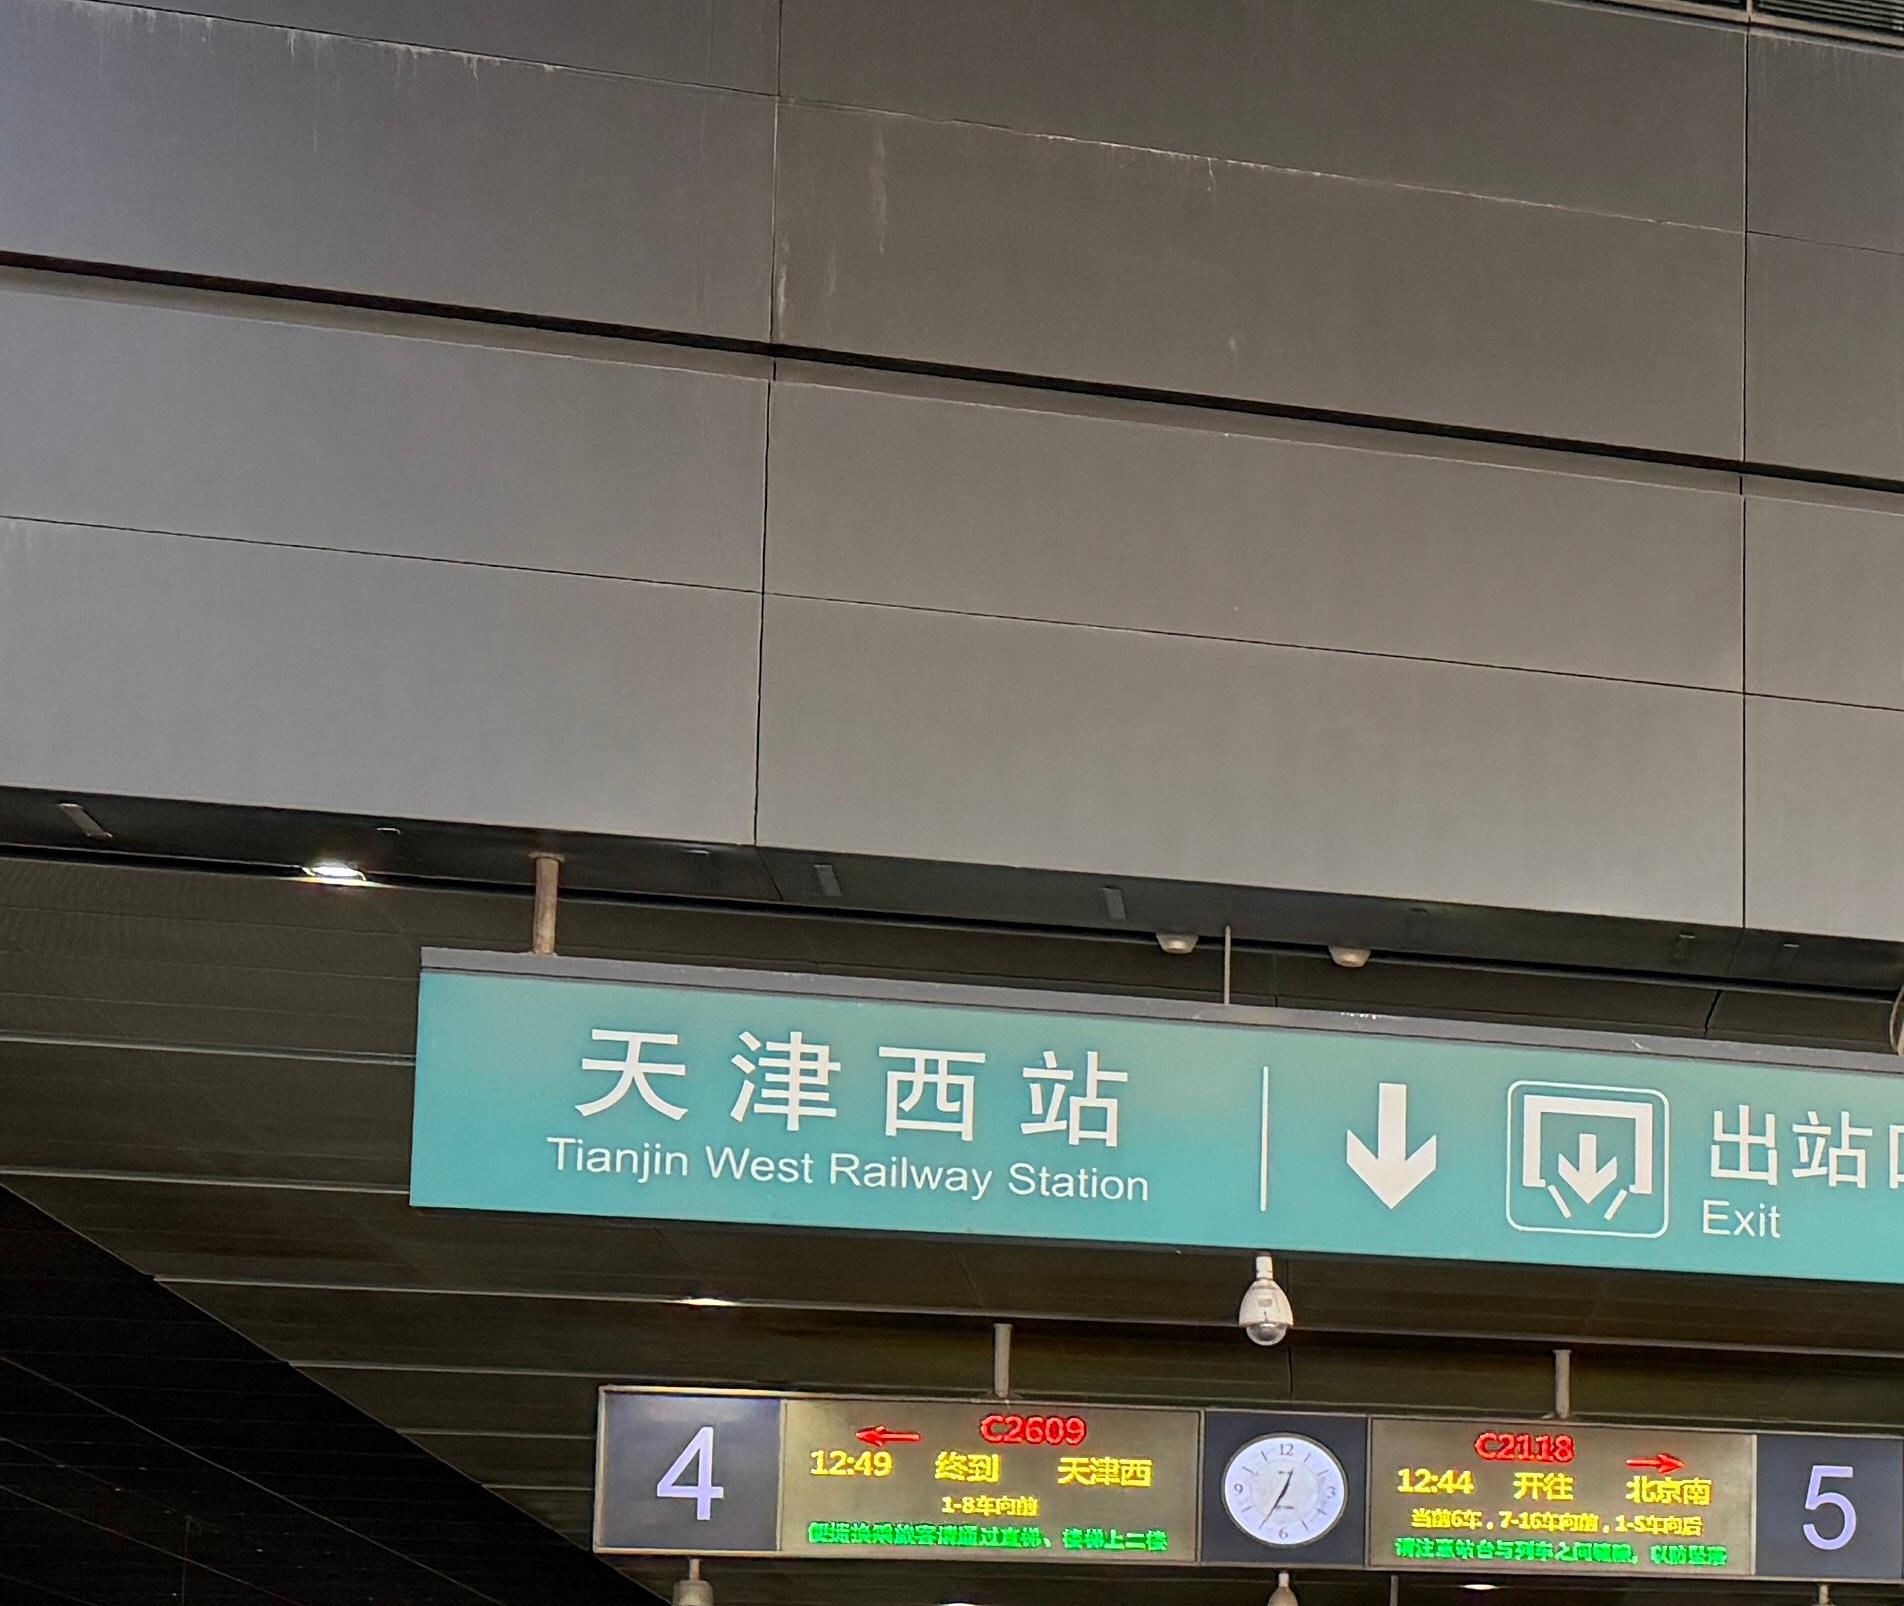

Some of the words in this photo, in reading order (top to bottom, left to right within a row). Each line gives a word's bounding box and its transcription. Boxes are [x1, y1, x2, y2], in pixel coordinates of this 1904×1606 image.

[574, 1028, 1130, 1147] 天津西站
[546, 1136, 690, 1185] Tianjin
[705, 1146, 813, 1184] West
[829, 1152, 993, 1201] Railway
[1007, 1162, 1149, 1201] Station
[1703, 1200, 1781, 1239] Exit
[980, 1414, 1087, 1445] C2609
[1279, 1443, 1294, 1456] 12
[1475, 1432, 1575, 1464] C2118
[657, 1426, 724, 1521] 4
[810, 1450, 893, 1477] 12:49
[934, 1452, 1000, 1484] 终到
[1057, 1457, 1153, 1487] 天津西
[1233, 1483, 1244, 1494] 9
[1397, 1469, 1474, 1495] 12:44
[1513, 1471, 1574, 1500] 开往
[1626, 1476, 1712, 1505] 北京南
[941, 1496, 1039, 1517] 1-8车向前
[1803, 1465, 1857, 1550] 5
[1279, 1527, 1289, 1539] 6
